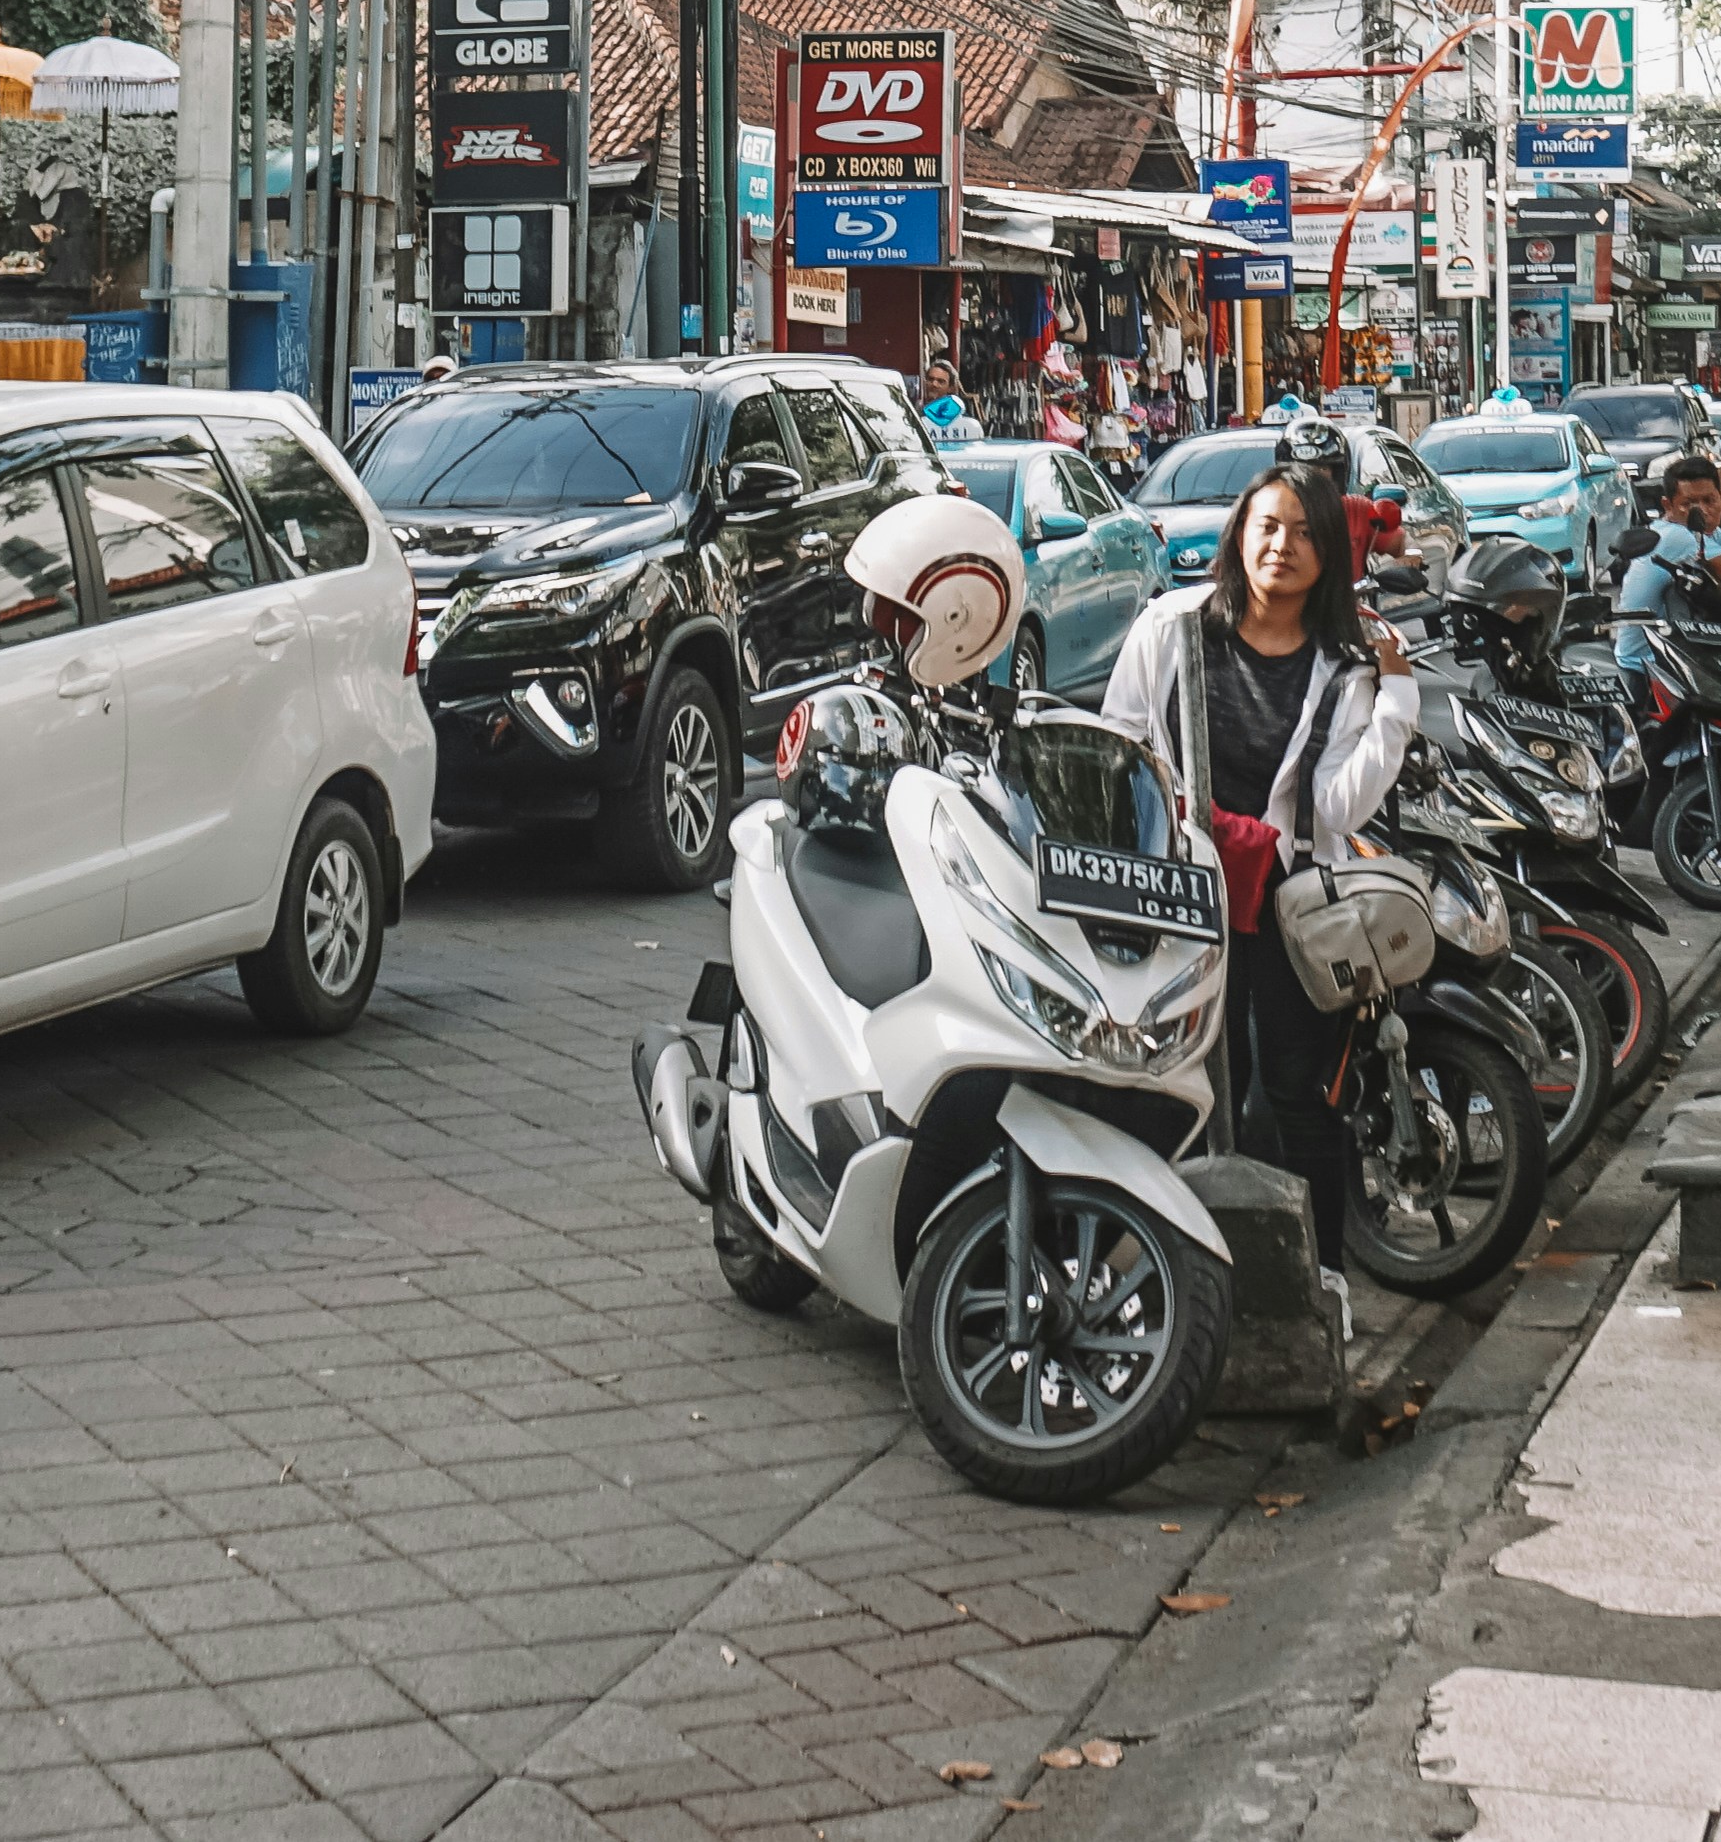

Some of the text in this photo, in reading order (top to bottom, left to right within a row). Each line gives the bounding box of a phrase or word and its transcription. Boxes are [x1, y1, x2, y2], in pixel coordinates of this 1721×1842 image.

[456, 36, 549, 66] GLOBE
[808, 40, 937, 59] GET MORE DISC
[816, 70, 925, 117] DVD
[1528, 93, 1630, 111] MINI MART
[805, 157, 826, 177] CD
[826, 195, 907, 206] HOUSE OF
[826, 248, 874, 261] Blu-ray
[1251, 269, 1280, 281] VISA
[463, 289, 521, 307] insight
[793, 292, 837, 315] BOOK HERE
[352, 382, 394, 401] MONEY
[930, 427, 967, 438] AKSI
